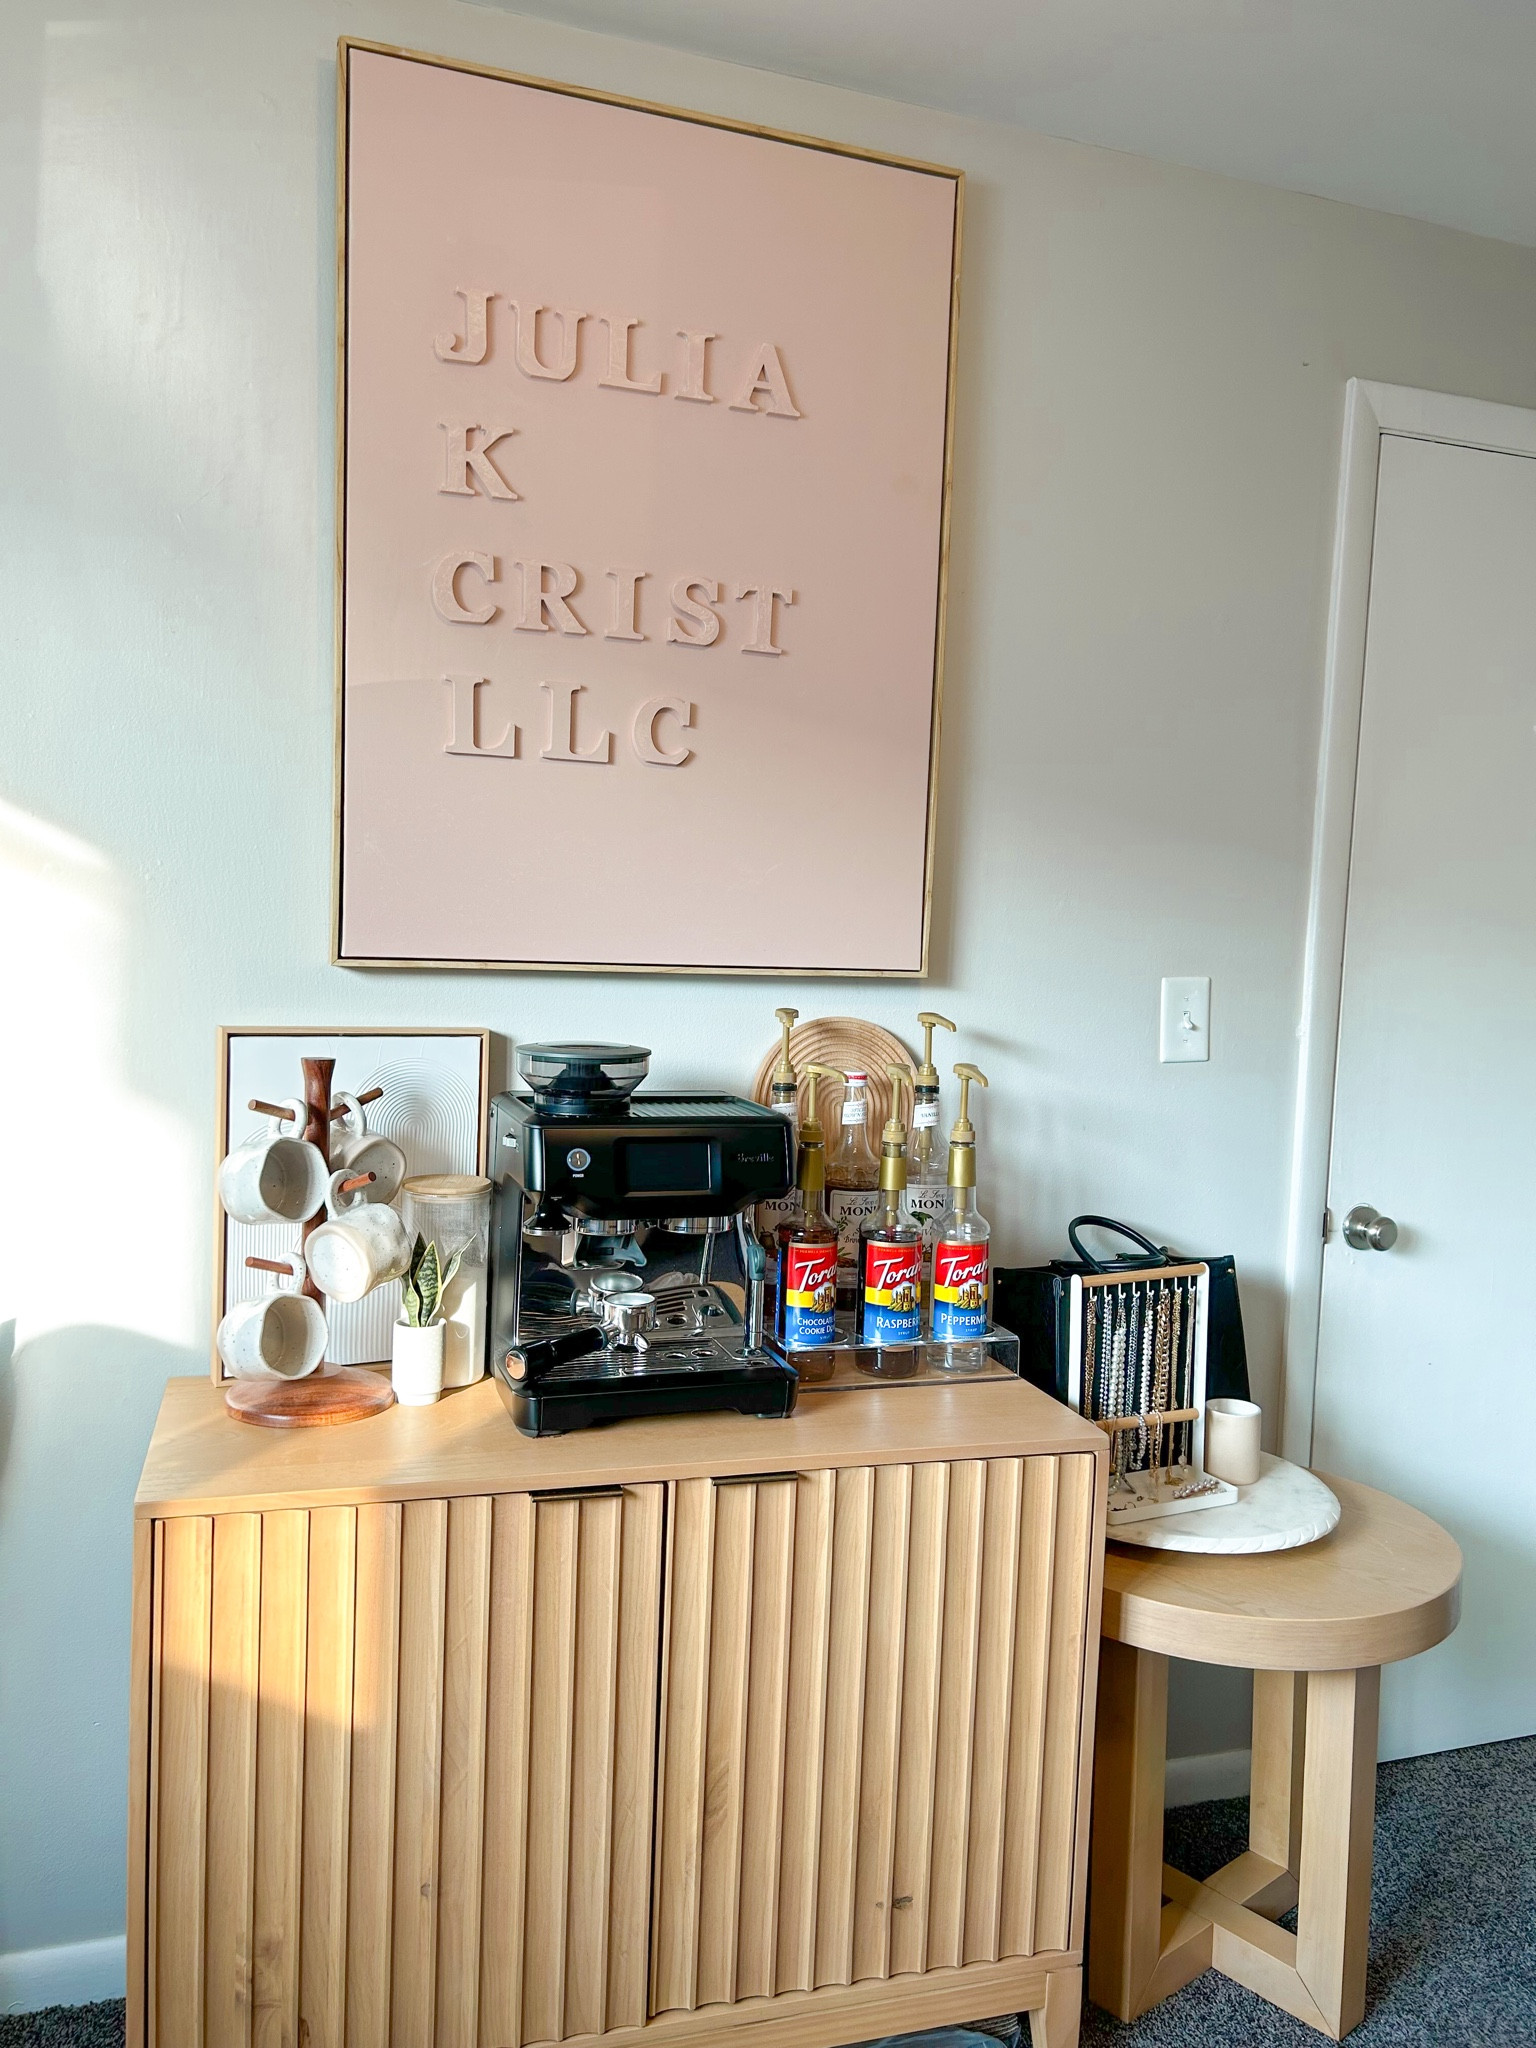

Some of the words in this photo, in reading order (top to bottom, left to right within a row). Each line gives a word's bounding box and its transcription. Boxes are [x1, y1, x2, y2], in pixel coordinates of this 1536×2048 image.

[434, 287, 803, 419] JULIA
[437, 420, 521, 501] K
[432, 550, 795, 656] CRIST
[443, 674, 694, 767] LLC
